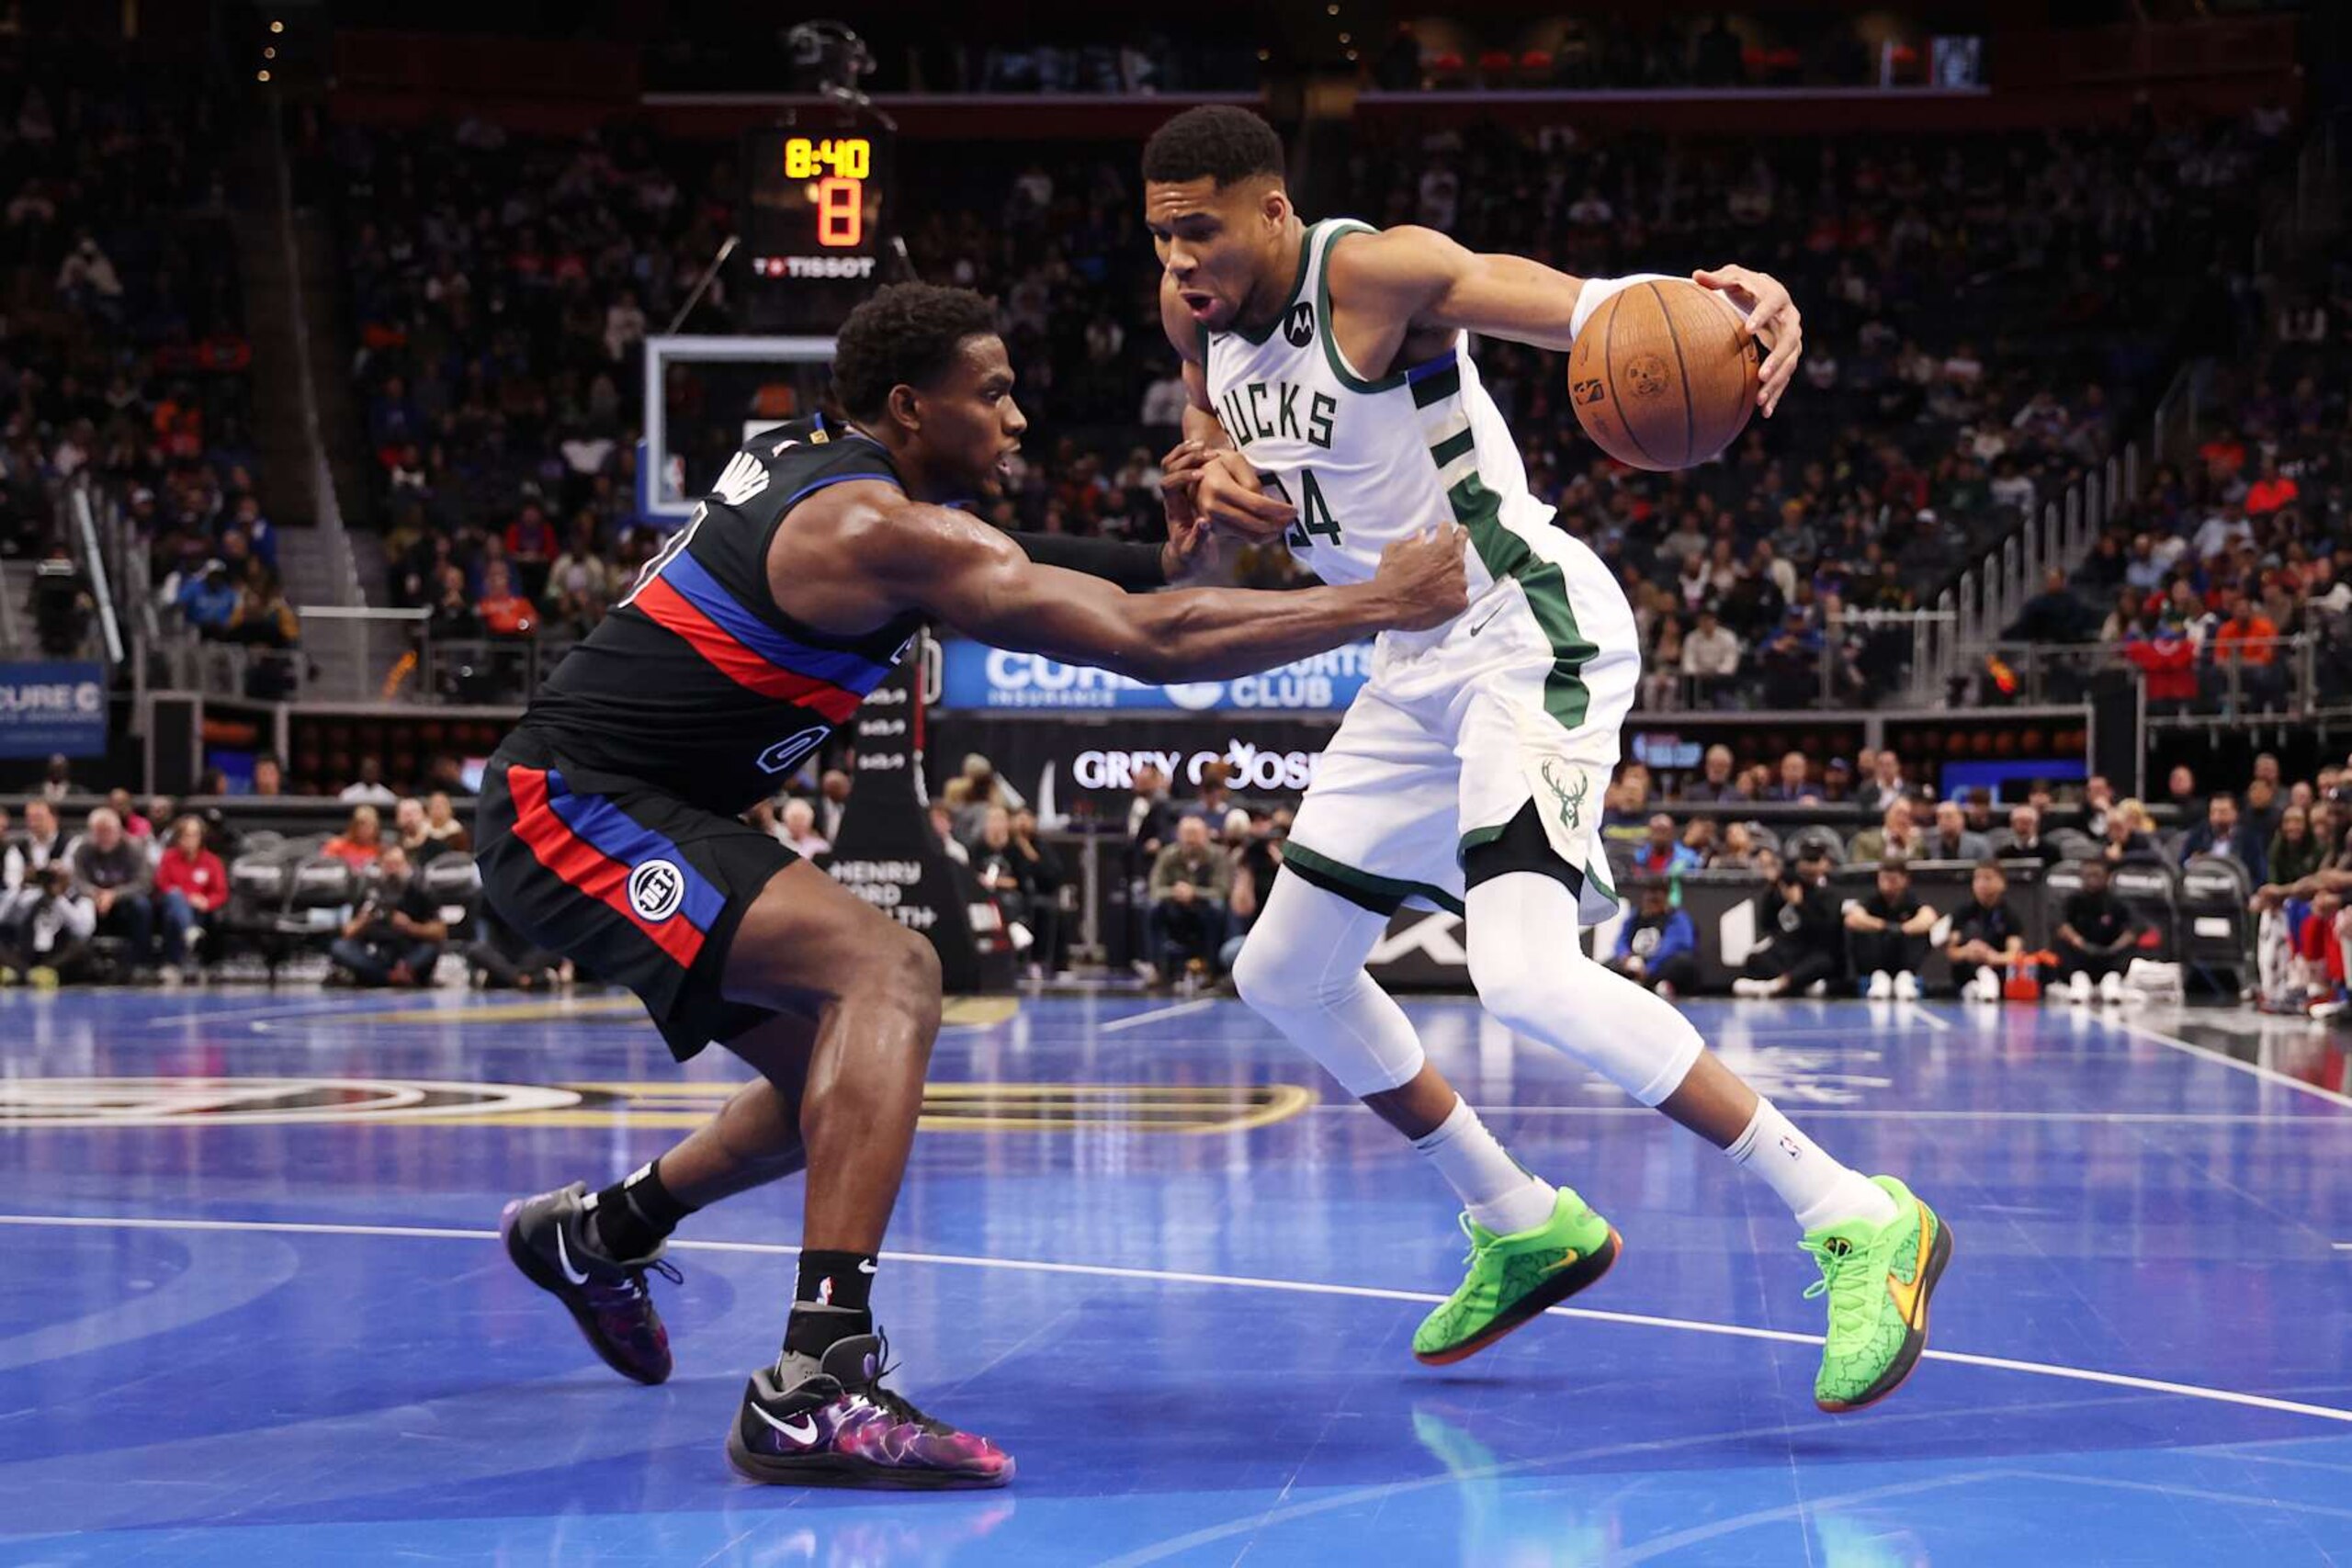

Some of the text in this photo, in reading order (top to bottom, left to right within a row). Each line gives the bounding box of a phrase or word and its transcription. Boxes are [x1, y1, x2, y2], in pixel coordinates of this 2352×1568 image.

[785, 139, 870, 179] 8:40
[819, 176, 862, 246] 8
[1231, 676, 1333, 707] CLUB
